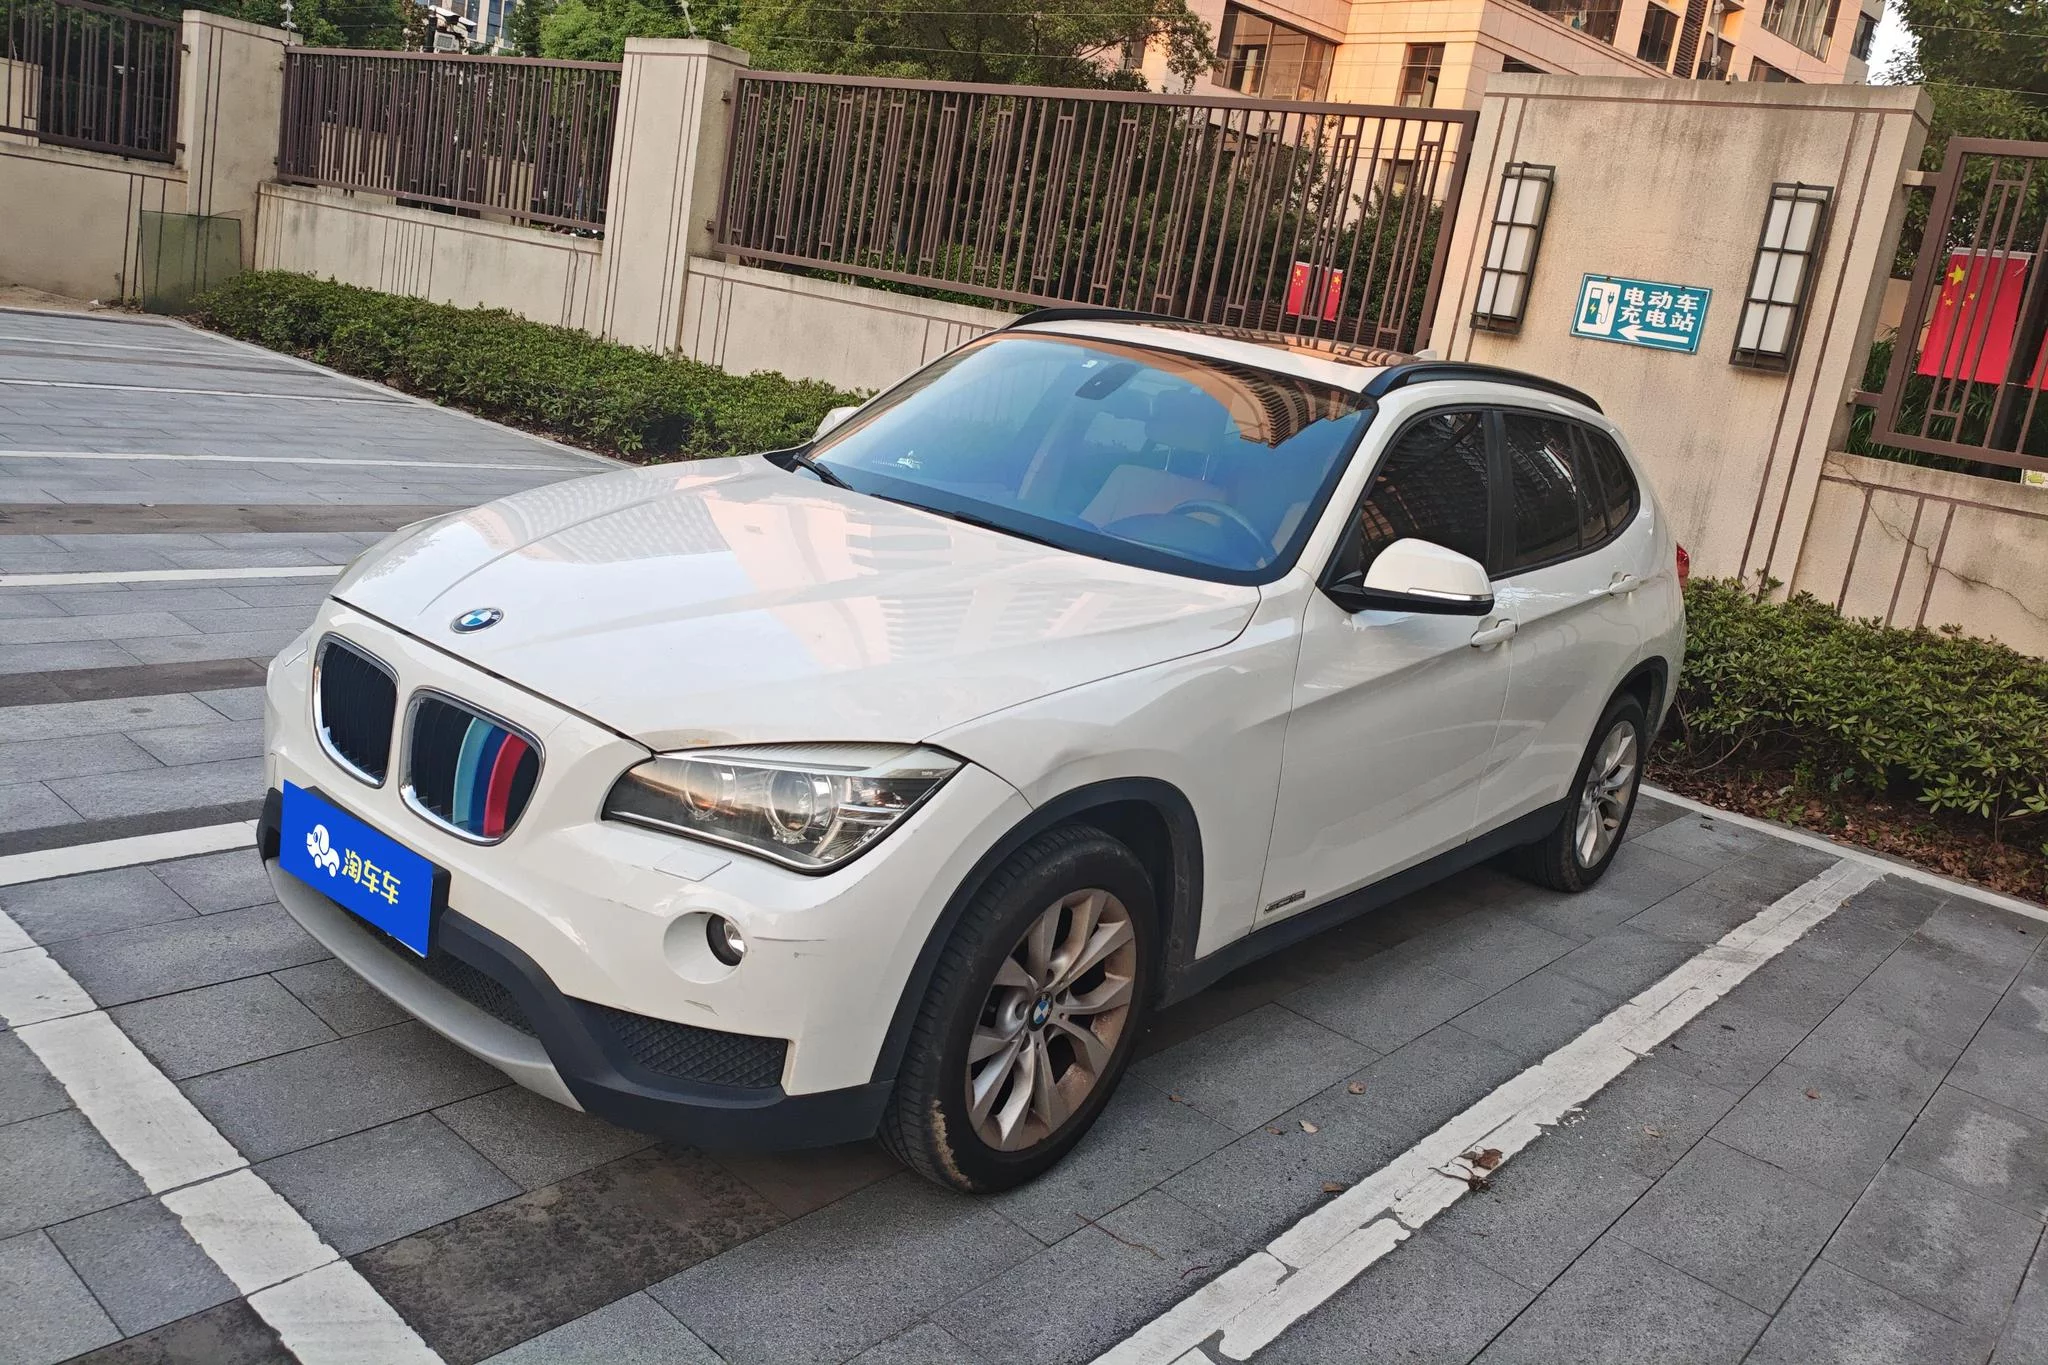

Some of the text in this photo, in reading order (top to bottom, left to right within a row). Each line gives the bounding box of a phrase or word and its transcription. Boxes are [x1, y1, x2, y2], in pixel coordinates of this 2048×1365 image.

[1624, 287, 1699, 312] 电动车
[1618, 305, 1696, 332] 充电站
